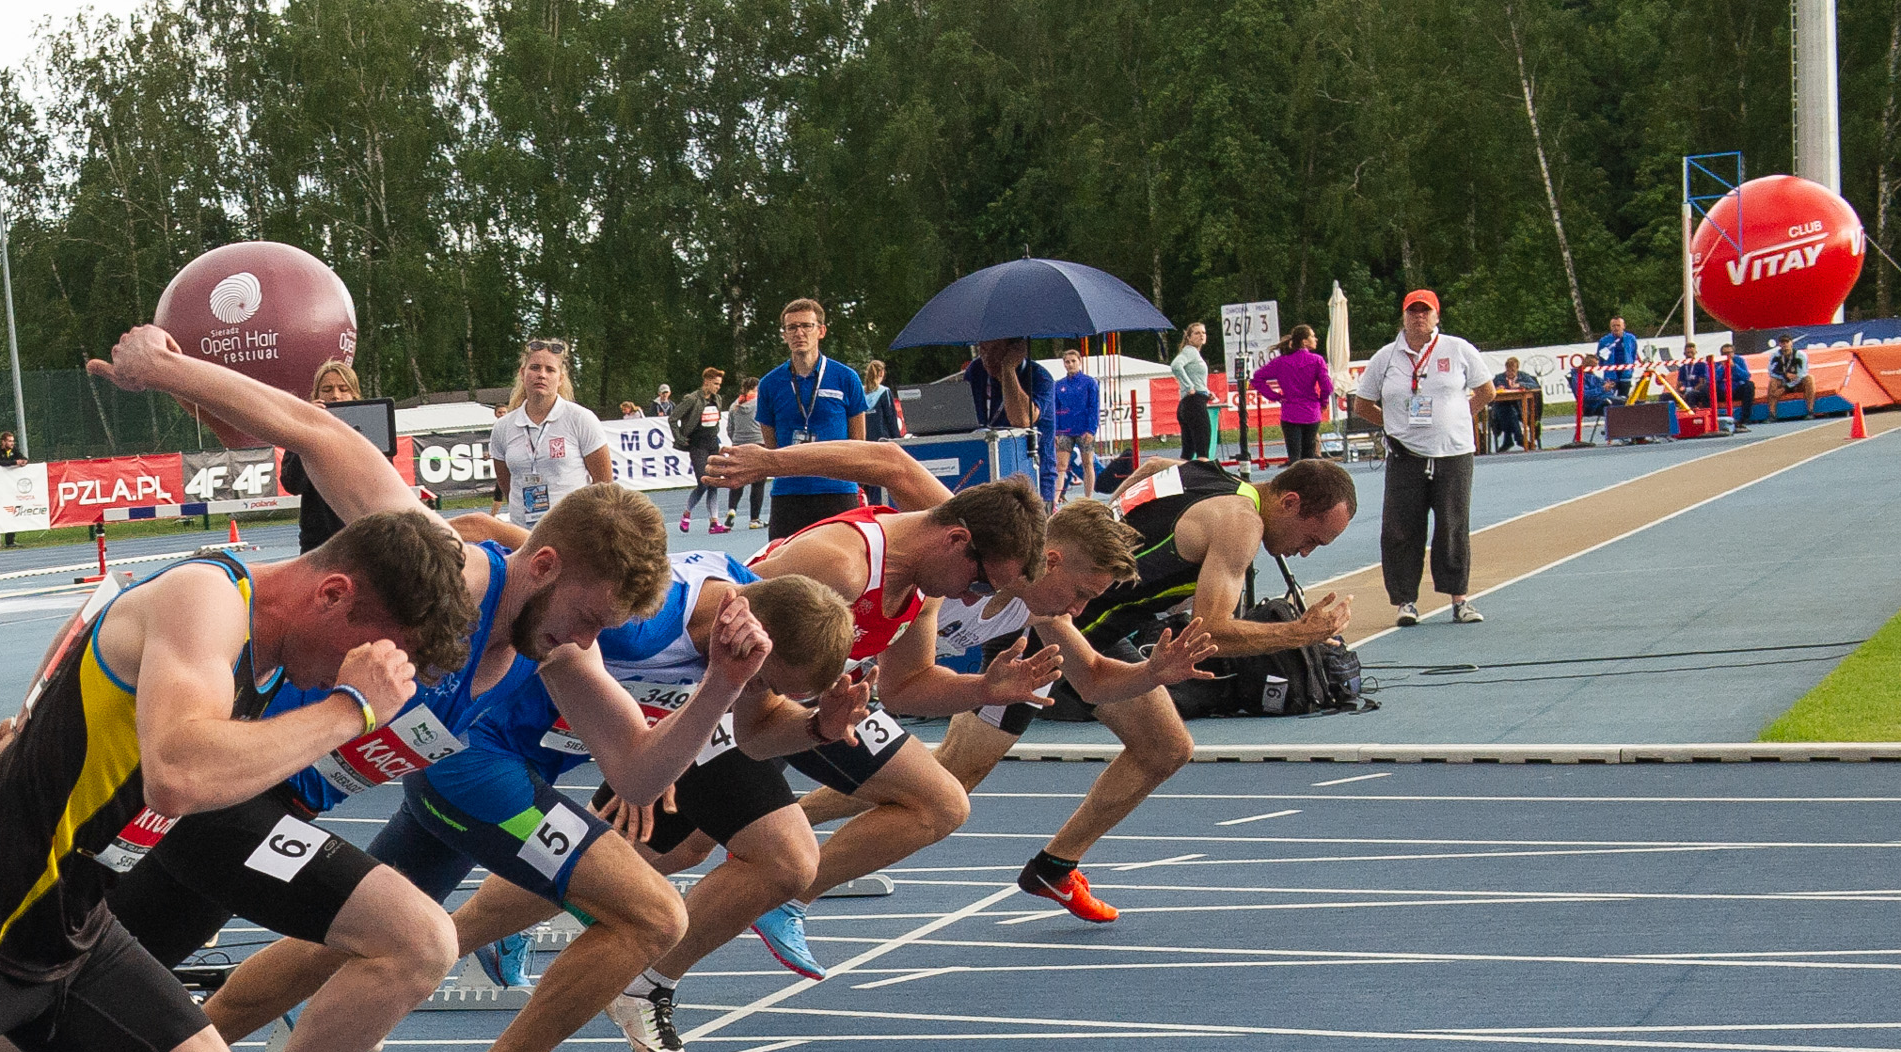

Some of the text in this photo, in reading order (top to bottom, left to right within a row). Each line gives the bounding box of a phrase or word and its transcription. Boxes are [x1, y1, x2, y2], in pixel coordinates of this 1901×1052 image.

[1788, 220, 1823, 238] CLUB
[1726, 243, 1826, 286] VITAY
[200, 329, 279, 356] Open Hair
[210, 327, 240, 338] Sieradz
[224, 348, 279, 364] festival
[58, 475, 172, 507] PZLA.PL
[185, 467, 227, 497] 4F
[232, 463, 274, 494] 4F
[250, 500, 278, 509] polanik
[640, 688, 690, 709] 349
[710, 723, 732, 747] 4
[864, 718, 889, 744] 3
[356, 737, 420, 779] KACZ
[536, 823, 571, 856] 5
